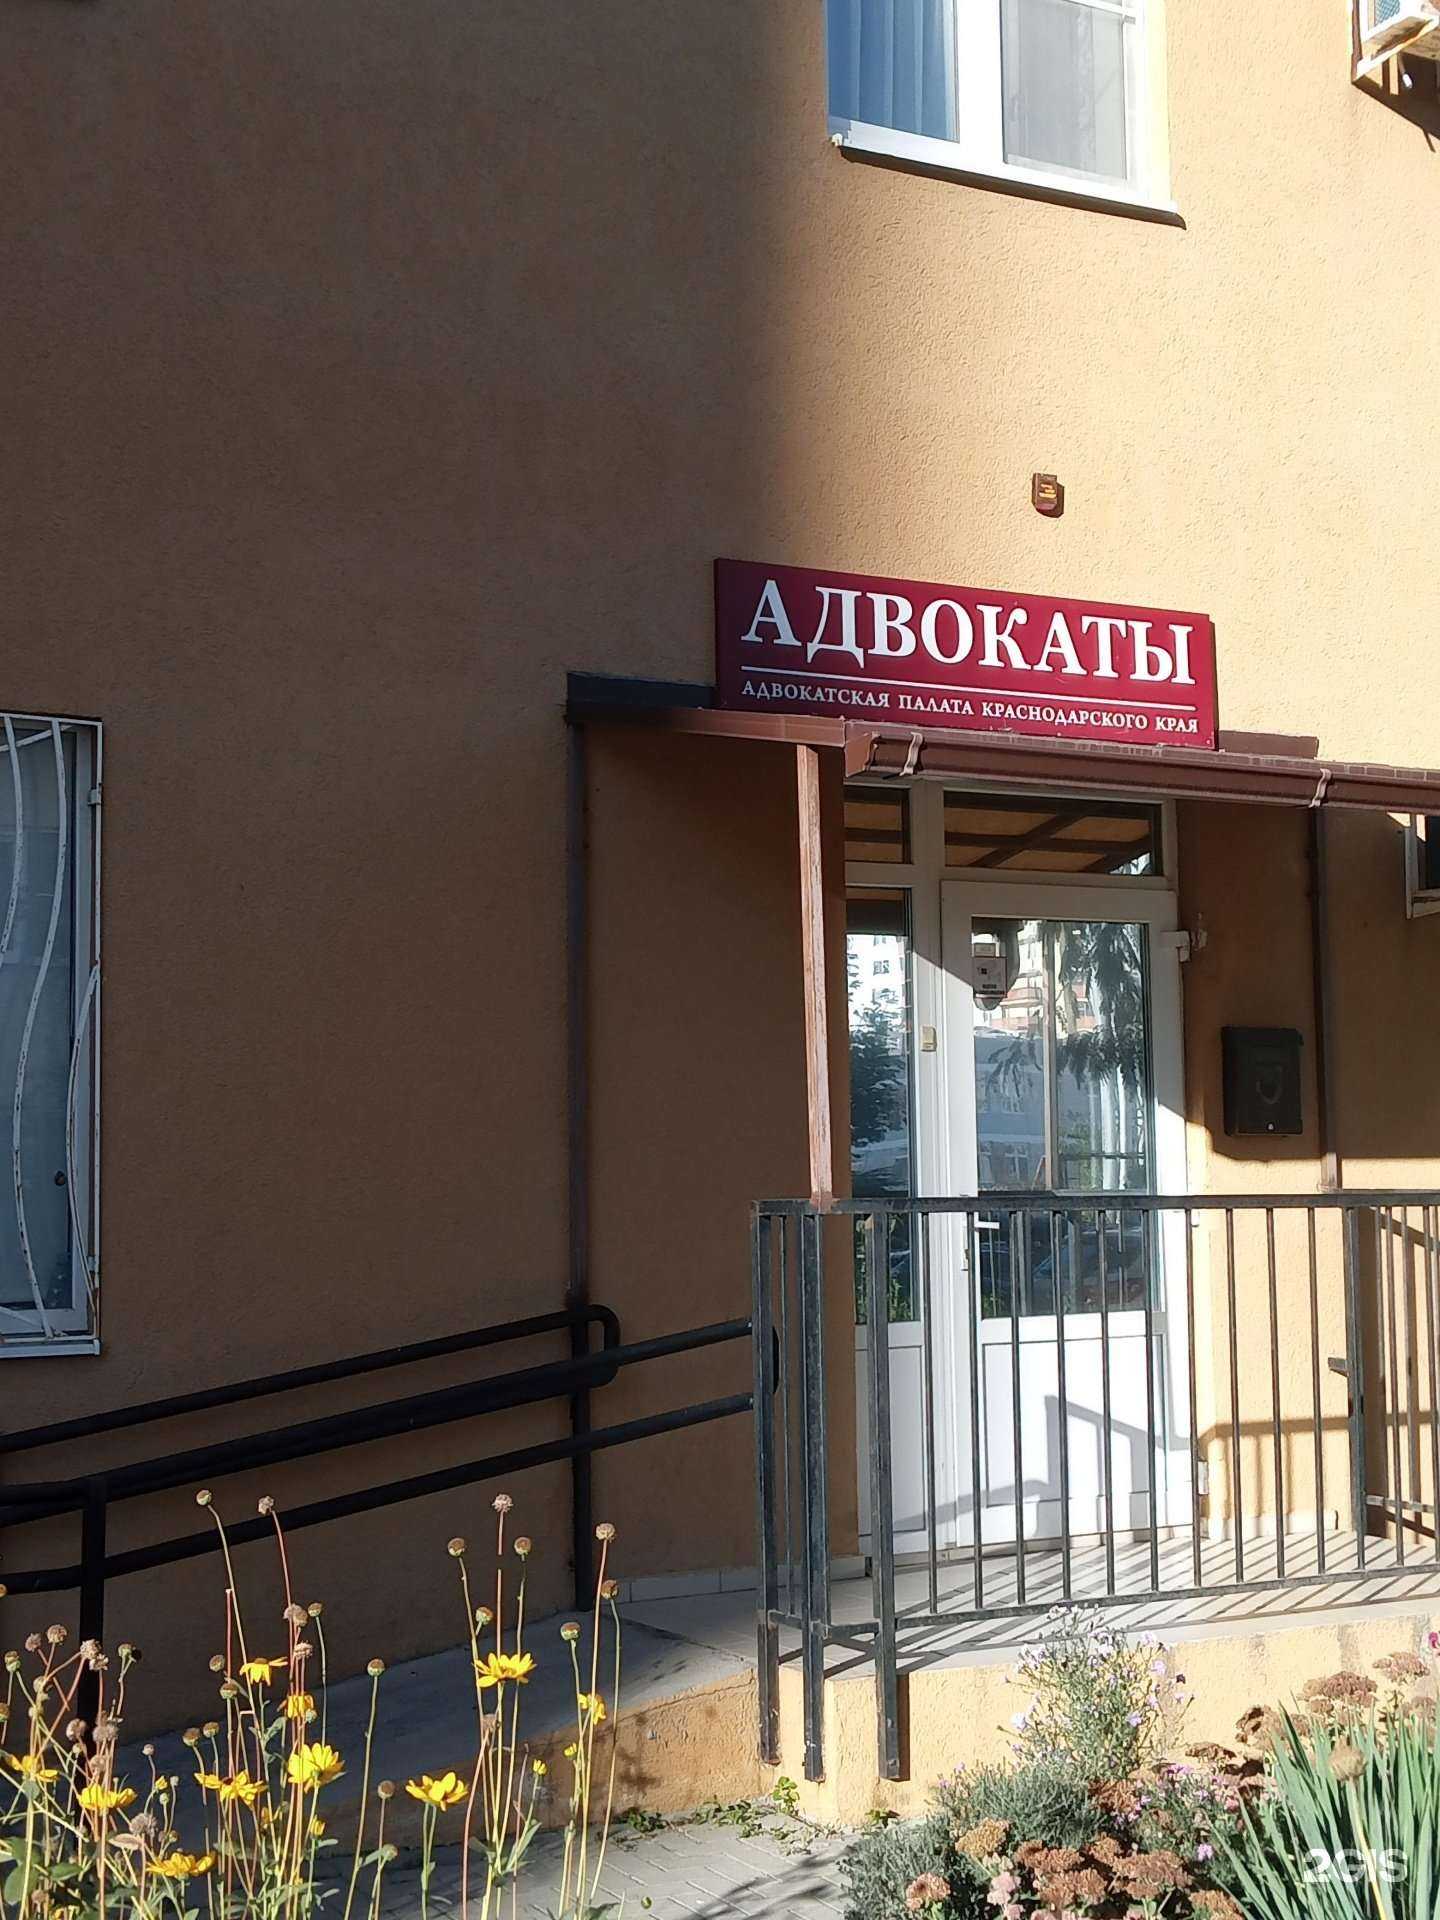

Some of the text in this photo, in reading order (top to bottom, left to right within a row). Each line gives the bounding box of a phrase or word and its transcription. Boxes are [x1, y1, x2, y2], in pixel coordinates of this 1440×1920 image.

[741, 579, 1196, 684] АДВОКАТЫ
[742, 680, 1198, 733] АДВОКАТСКАЯ ПАЛАТА КРАСНОДАРСКОГО КРАЯ
